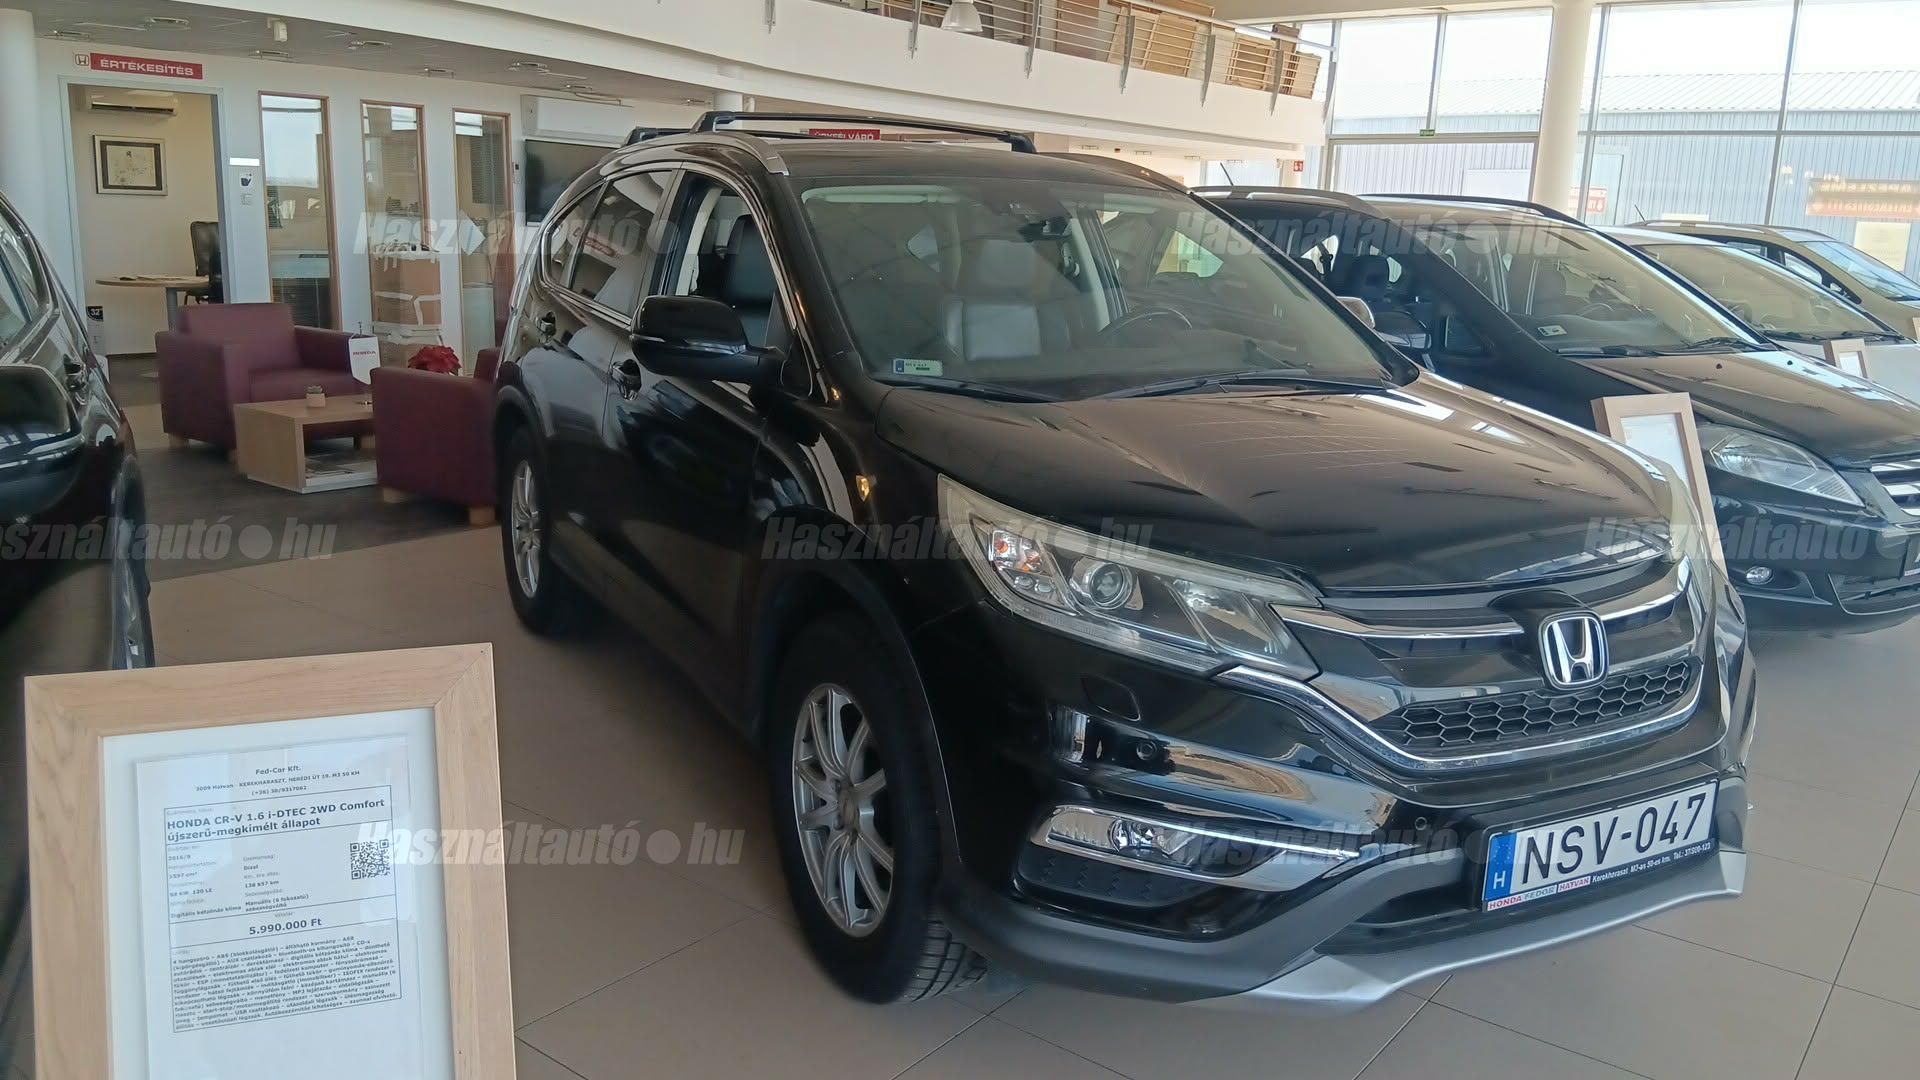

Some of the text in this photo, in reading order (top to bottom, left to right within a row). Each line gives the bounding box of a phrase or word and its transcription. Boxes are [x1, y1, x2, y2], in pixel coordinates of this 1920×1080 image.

[100, 59, 193, 76] ÉRTÉKESÍTÉS
[255, 766, 284, 775] Fed-Car
[167, 798, 384, 829] HONDA CR-V 1.6 i-DTEC 2WD Comfort
[167, 816, 320, 842] újszerű-megkímélt állapot
[1522, 792, 1706, 884] NSV-047
[1493, 870, 1506, 889] H
[1489, 896, 1522, 909] HONDA
[1525, 886, 1555, 899] FEDOR
[1559, 877, 1590, 890] HATVAN
[249, 917, 322, 935] 5.990.000 Ft
